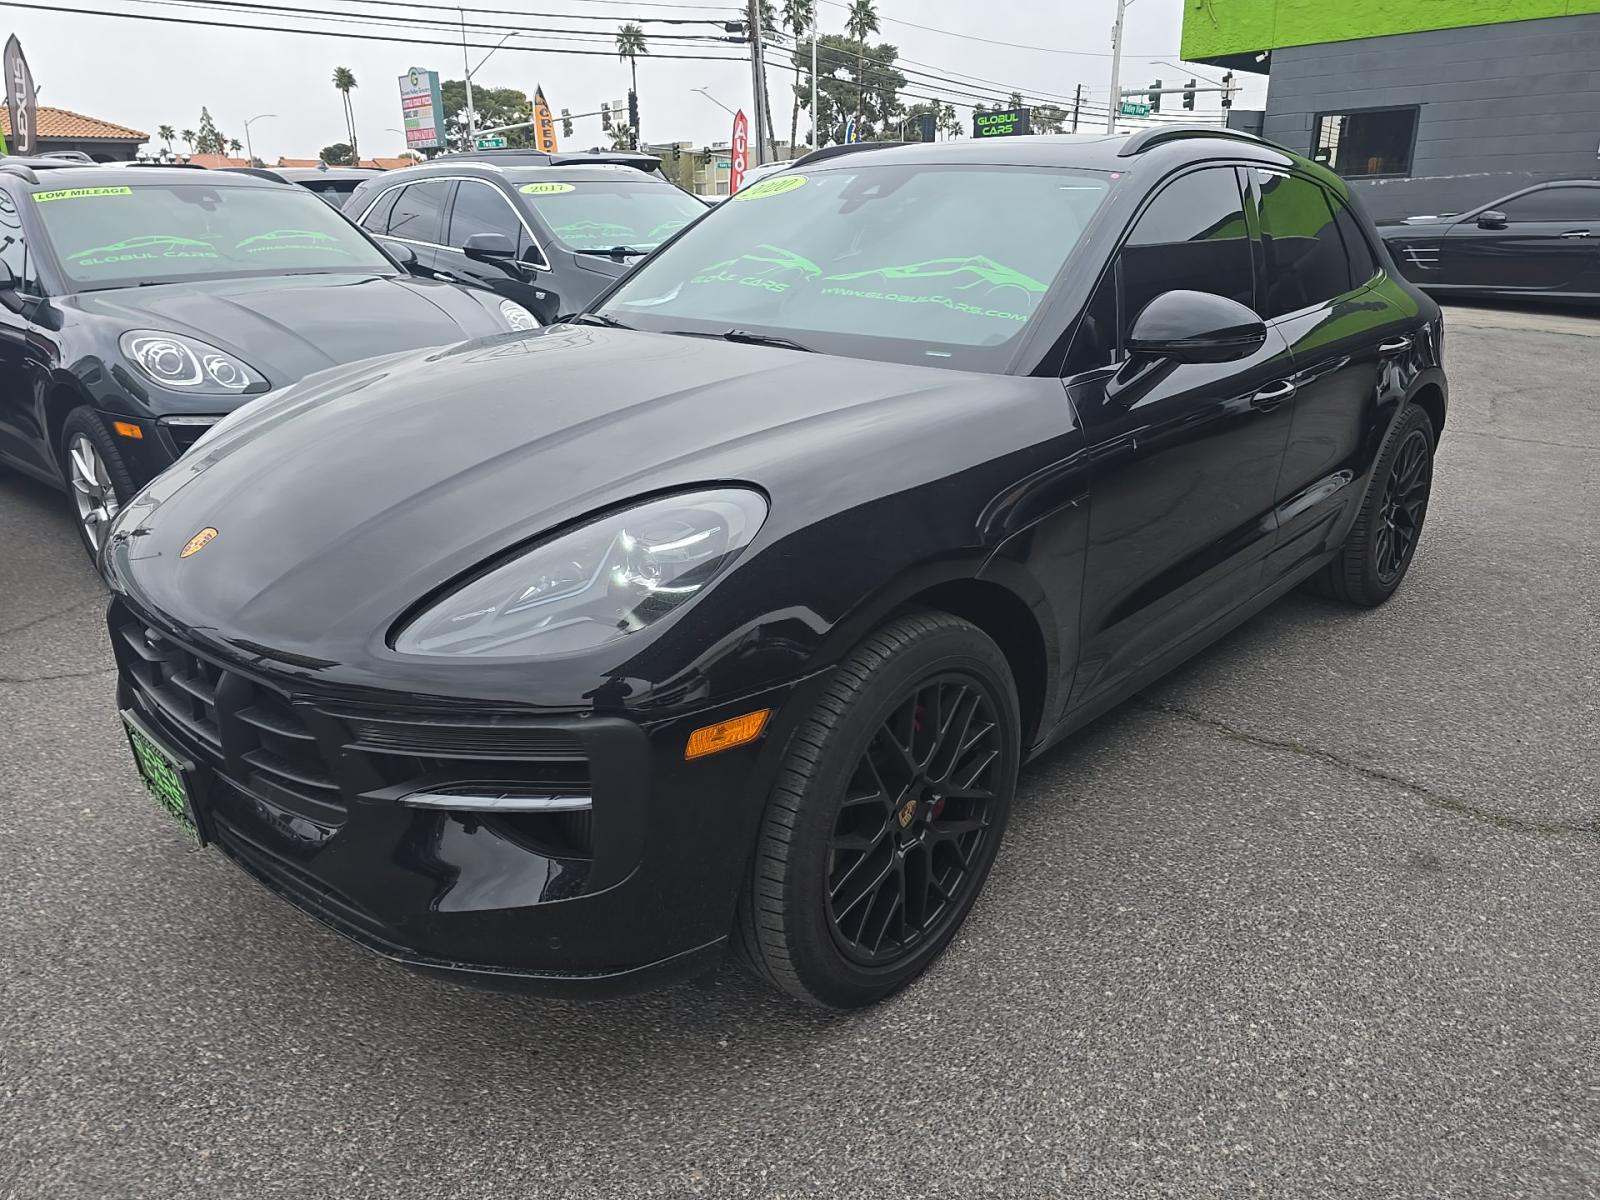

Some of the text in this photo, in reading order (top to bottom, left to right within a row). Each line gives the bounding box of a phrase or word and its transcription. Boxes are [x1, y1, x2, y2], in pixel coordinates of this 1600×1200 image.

[13, 54, 28, 151] LEXUS
[977, 113, 1019, 125] GLOBUL
[982, 124, 1013, 135] CARS
[734, 120, 747, 188] AUDI
[38, 186, 128, 200] LOW MILEAGE
[79, 250, 218, 266] GLOBUL CARS
